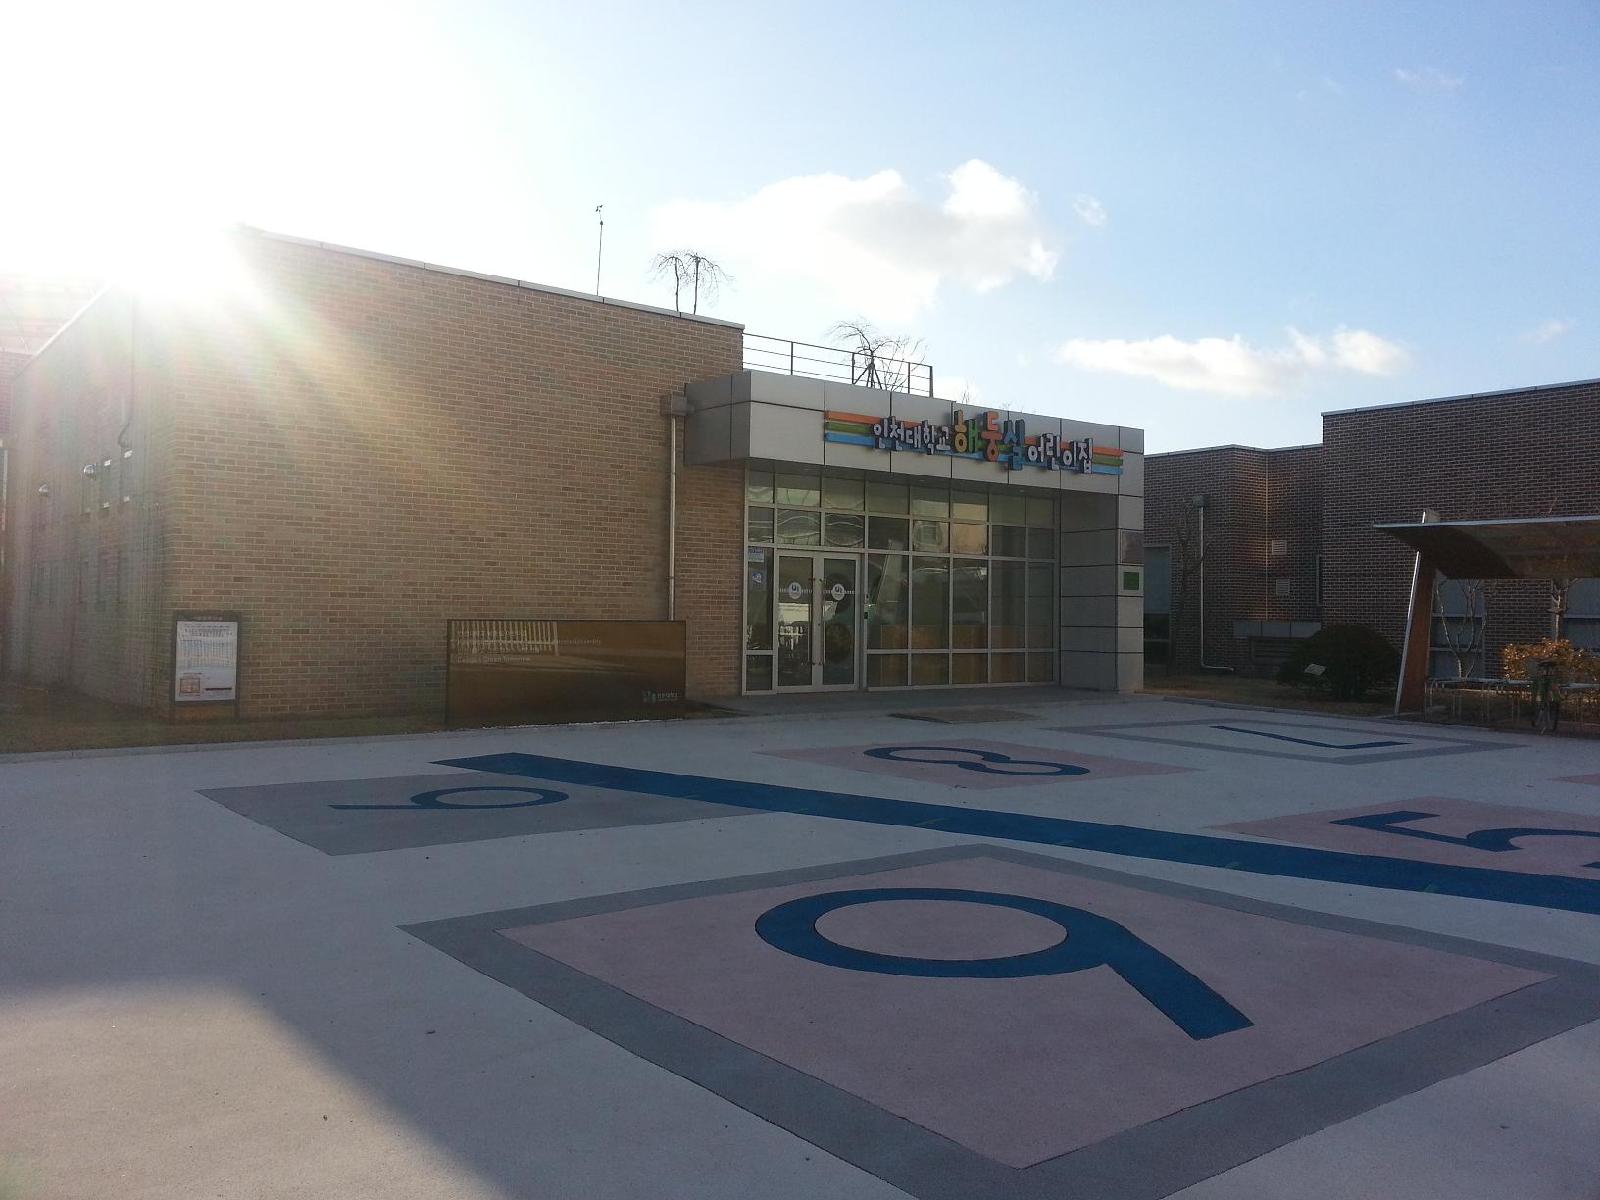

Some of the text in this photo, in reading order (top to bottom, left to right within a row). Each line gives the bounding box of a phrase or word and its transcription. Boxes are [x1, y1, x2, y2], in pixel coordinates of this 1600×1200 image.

[873, 409, 1094, 474] 인천대학교 해둥실 어린이집
